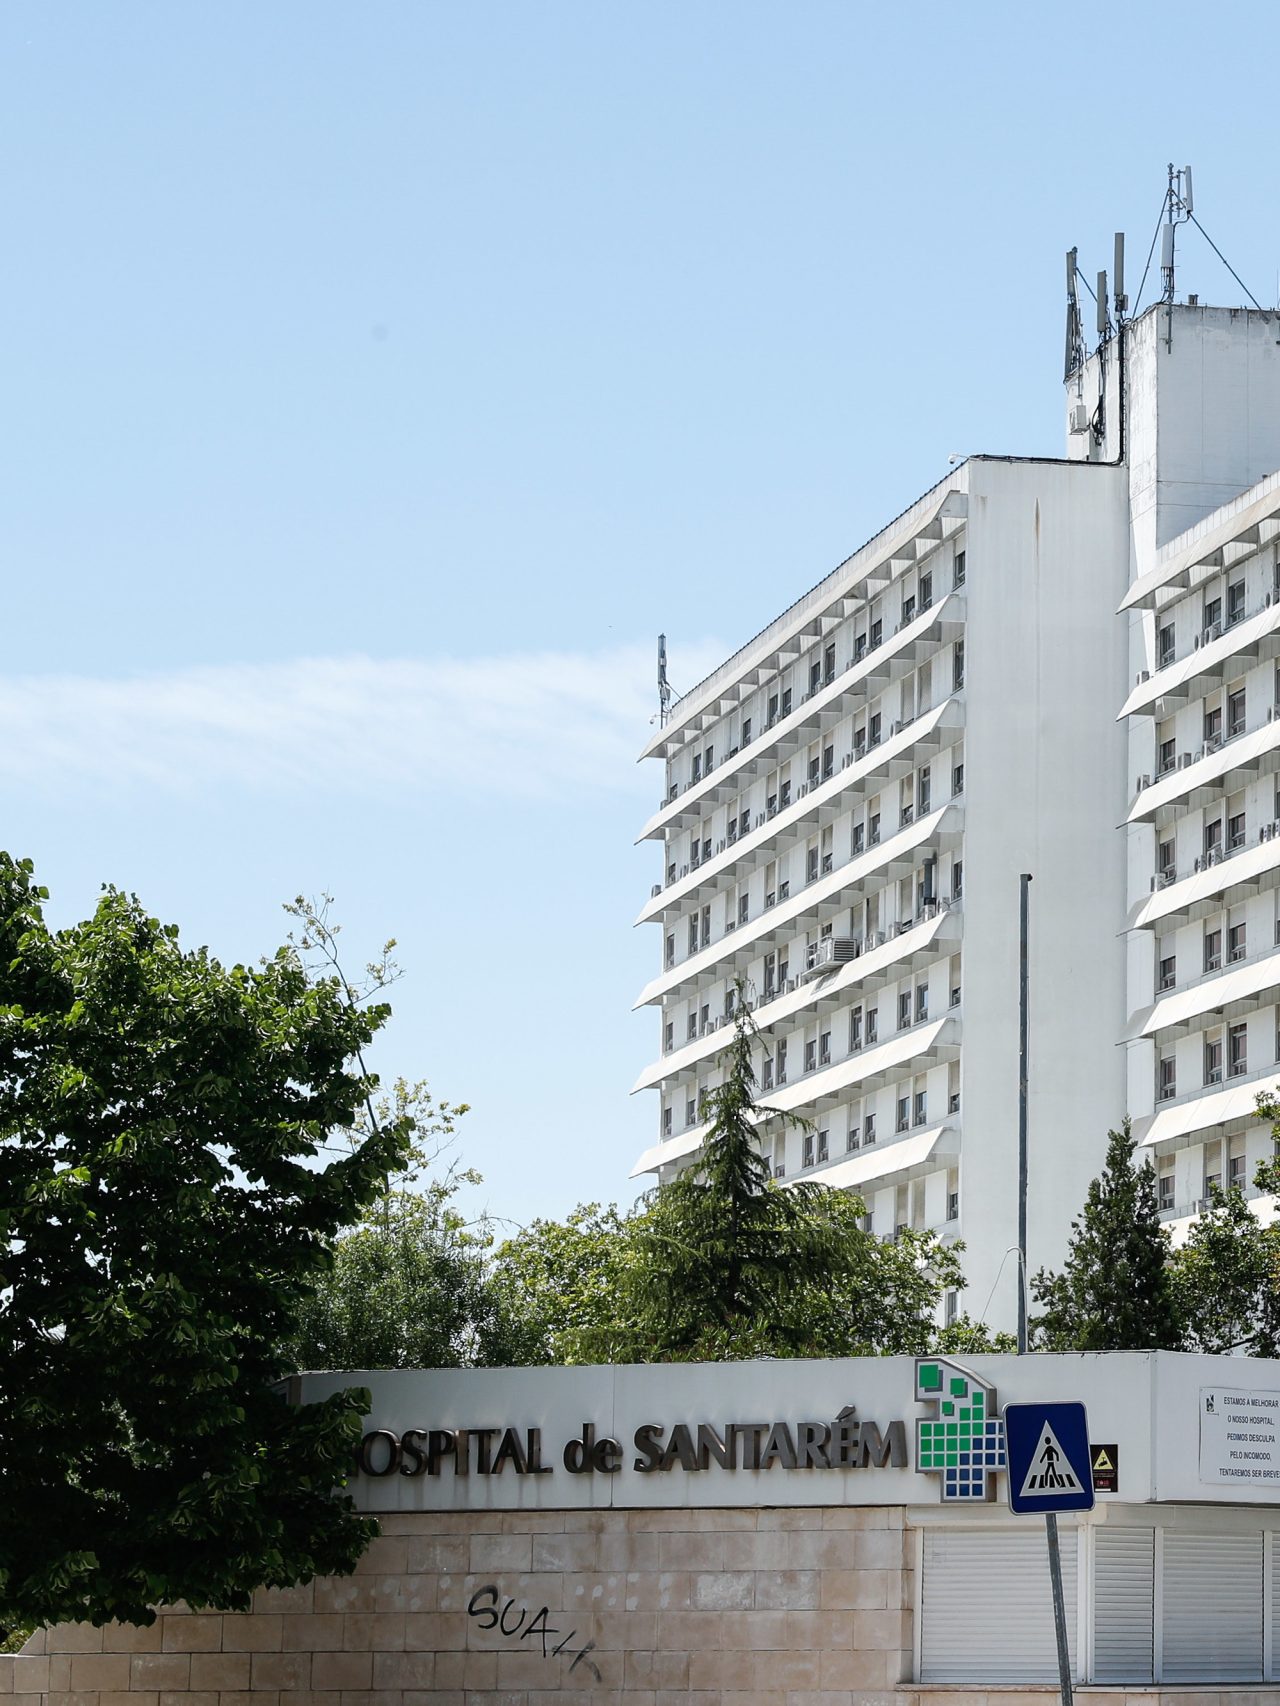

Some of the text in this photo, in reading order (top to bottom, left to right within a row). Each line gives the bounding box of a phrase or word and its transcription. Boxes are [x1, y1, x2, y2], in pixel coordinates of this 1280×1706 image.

[1224, 1396, 1279, 1408] ESTAMOS A MELHORAR
[1228, 1415, 1231, 1423] O
[1232, 1415, 1248, 1423] NOSSO
[351, 1405, 908, 1477] OSPITAL de SANTARÉM
[1227, 1433, 1275, 1443] PEDIMOS DESCULPA
[1230, 1451, 1242, 1459] PELO
[1219, 1468, 1251, 1477] TENTAREMOS
[1251, 1469, 1262, 1478] SER
